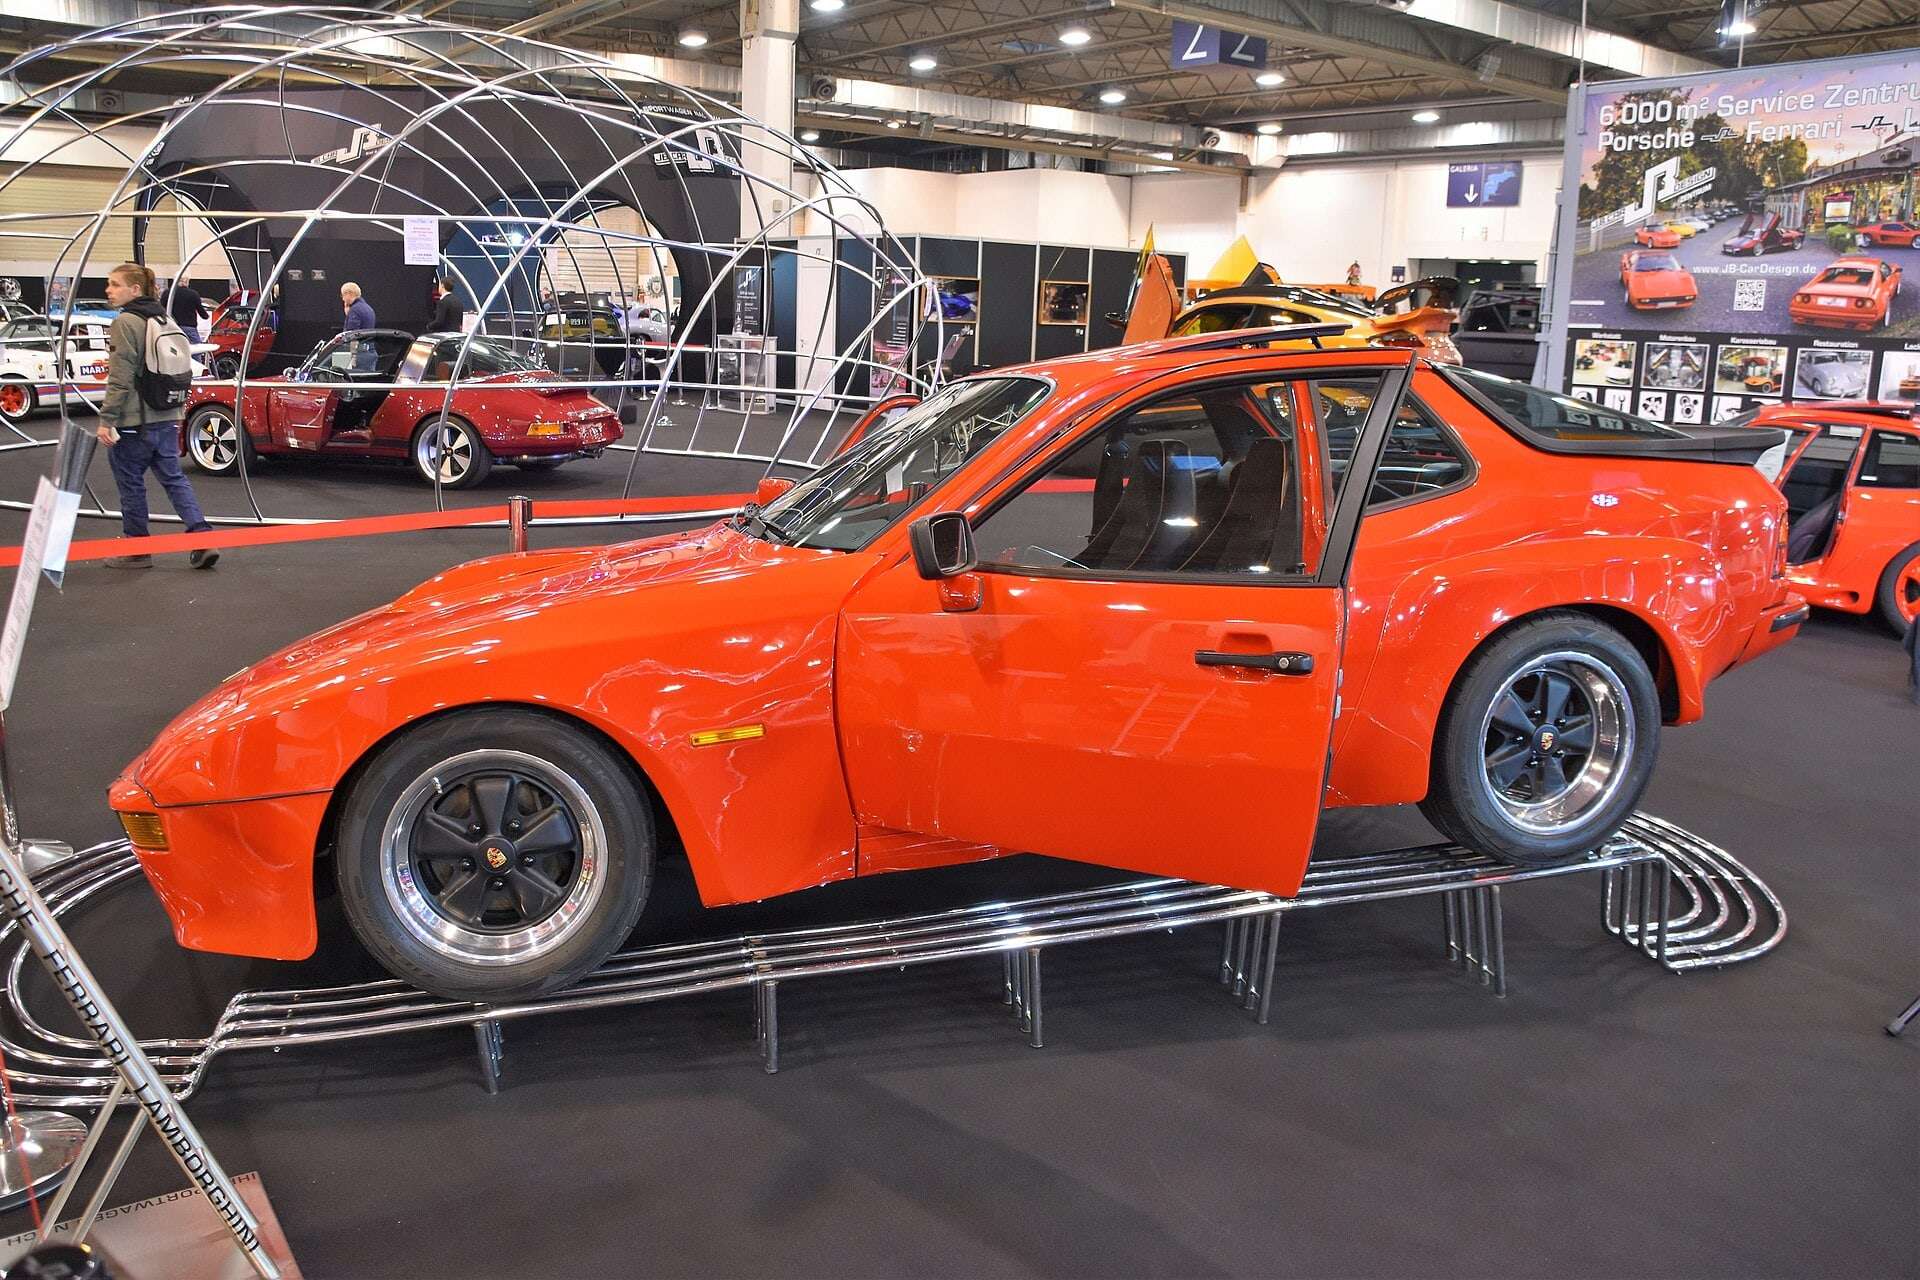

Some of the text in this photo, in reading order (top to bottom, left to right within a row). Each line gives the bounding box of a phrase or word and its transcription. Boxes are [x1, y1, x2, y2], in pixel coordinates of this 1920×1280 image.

[1599, 100, 1673, 126] 6.000
[1717, 89, 1814, 117] Service
[1598, 127, 1696, 152] Porsche
[1745, 114, 1843, 144] Ferrari
[1692, 263, 1817, 277] www.JB-CarDesign.de
[1813, 339, 1859, 349] Restauration
[43, 949, 130, 1066] FERRARI
[134, 1083, 260, 1252] LAMBORGHINI
[94, 1188, 202, 1223] PORTWAGE
